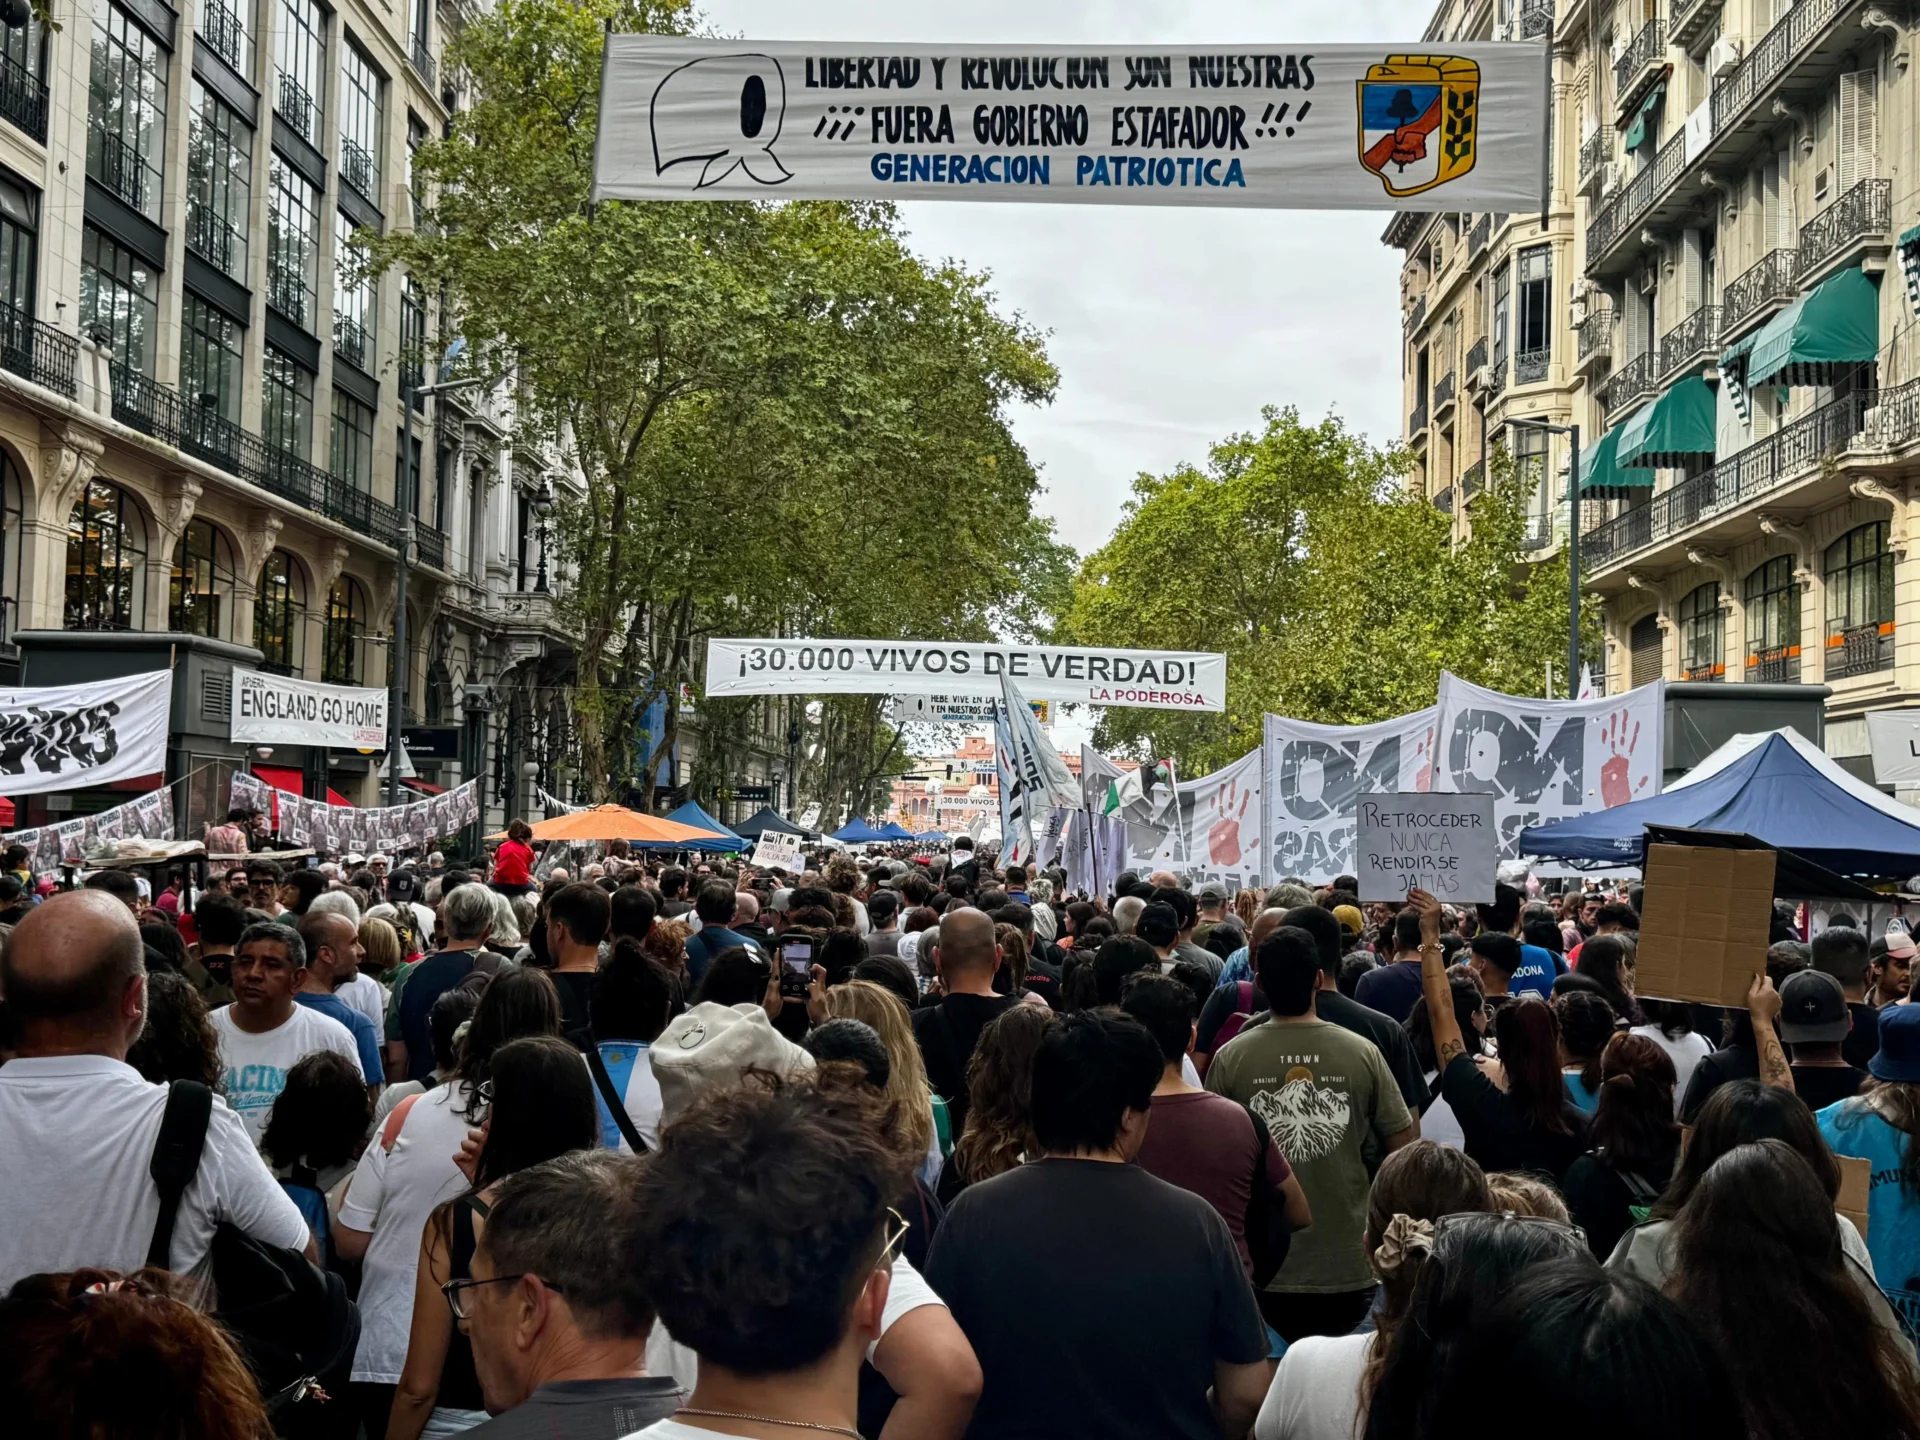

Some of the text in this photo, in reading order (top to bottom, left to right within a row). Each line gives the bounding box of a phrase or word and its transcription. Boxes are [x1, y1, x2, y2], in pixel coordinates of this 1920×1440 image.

[805, 55, 1315, 92] LIBERTAD Y REVOLUCION SON NUESTRAS
[973, 104, 1088, 147] GOBIERNO
[871, 153, 1247, 188] GENERACION PATRIOTICA
[739, 646, 1196, 687] ¡30.000 VIVOS DE VERDAD!
[241, 688, 383, 728] ENGLAND GO HOME
[931, 695, 949, 704] HEBE
[952, 695, 969, 704] VIVE
[937, 705, 946, 714] EN
[949, 705, 981, 715] NUESTROS
[1090, 688, 1205, 706] LA PODEROSA
[1362, 802, 1483, 828] RETROCEDER
[1391, 832, 1453, 852] NUNCA
[1280, 1055, 1319, 1063] TROWN
